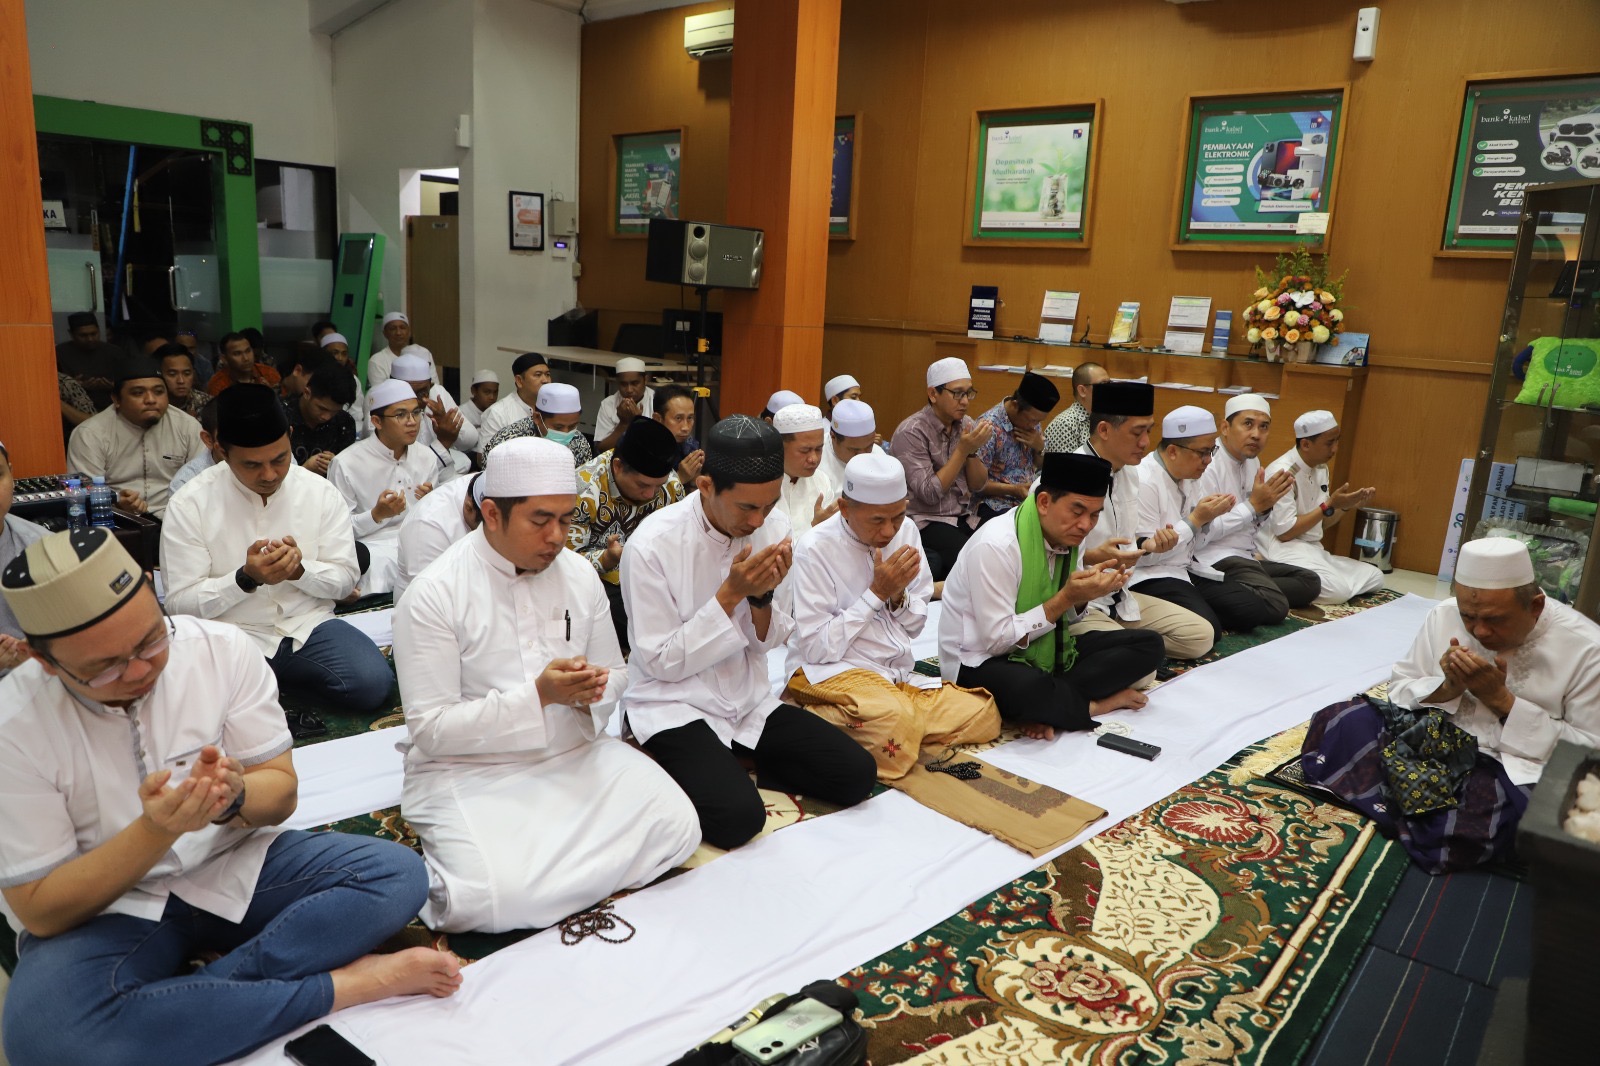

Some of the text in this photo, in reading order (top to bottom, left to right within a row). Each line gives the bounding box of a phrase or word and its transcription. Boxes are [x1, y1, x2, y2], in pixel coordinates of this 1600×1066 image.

[1202, 142, 1254, 151] PEMBIAYAAN
[1204, 150, 1251, 159] ELEKTRONIK
[1498, 198, 1524, 206] BE
[1495, 465, 1506, 492] ASUHAN
